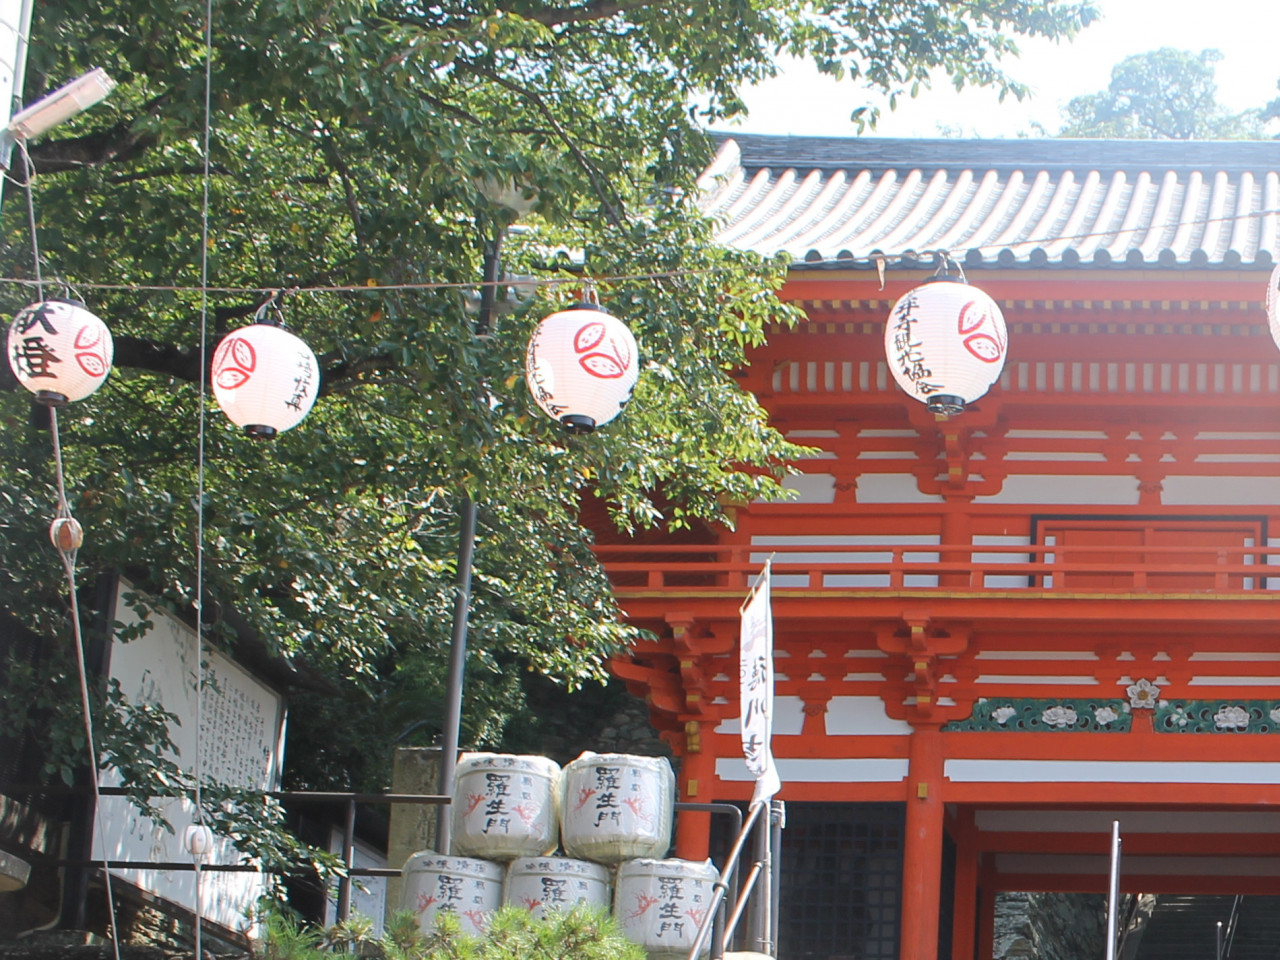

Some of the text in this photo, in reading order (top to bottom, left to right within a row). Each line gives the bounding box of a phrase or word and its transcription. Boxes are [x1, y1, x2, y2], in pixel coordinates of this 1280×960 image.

[482, 773, 511, 834] 羅生門
[593, 767, 621, 828] 羅生門
[656, 877, 685, 938] 羅生門
